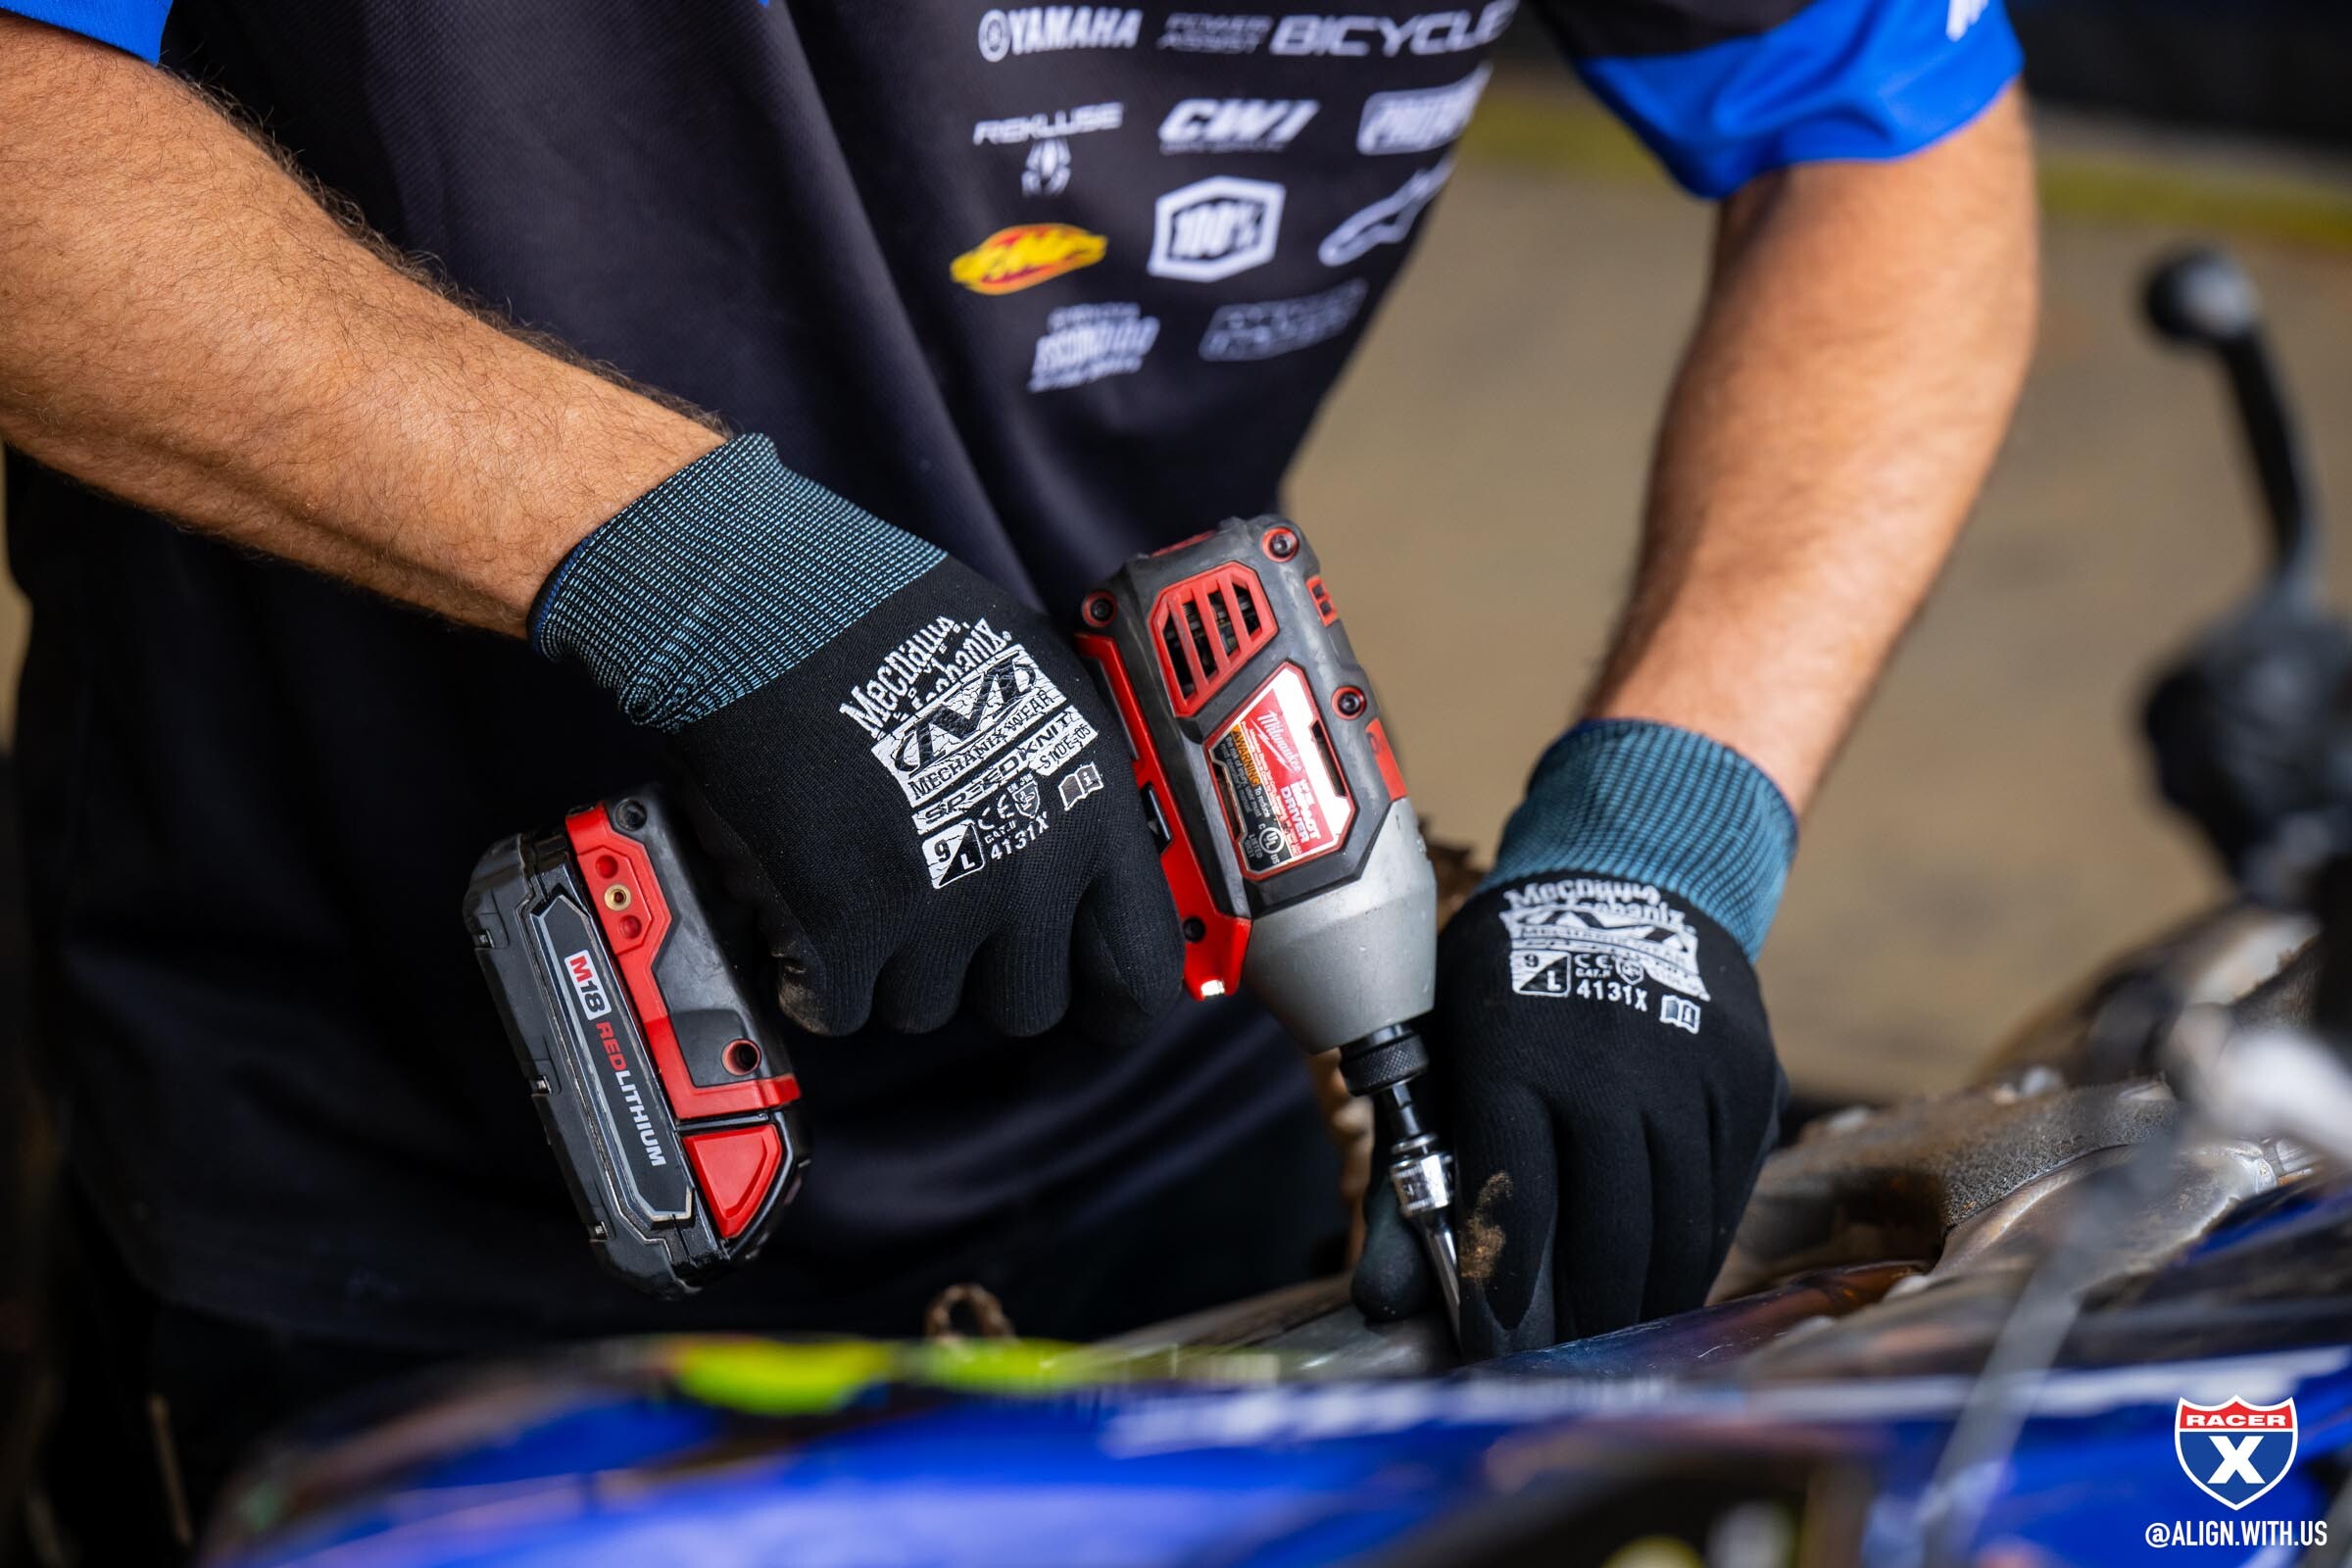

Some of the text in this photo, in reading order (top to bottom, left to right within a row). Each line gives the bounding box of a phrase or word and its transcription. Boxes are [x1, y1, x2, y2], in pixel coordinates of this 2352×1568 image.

[1007, 5, 1144, 56] YAMAHA
[973, 101, 1124, 146] REKLUSE
[907, 689, 1055, 801] MECHANIX WEAR
[1257, 710, 1299, 771] Milwaukee
[924, 714, 1073, 824] SPEEDKNIT
[1234, 738, 1271, 817] WARNING To reduce
[990, 810, 1050, 861] 4131X
[1279, 785, 1309, 843] DRIVER
[933, 839, 953, 864] 9
[959, 853, 977, 870] L
[1248, 833, 1263, 858] LISTED
[1269, 853, 1280, 864] US
[1523, 955, 1541, 969] 9
[1546, 969, 1562, 992] L
[1576, 979, 1649, 1011] 4131X
[569, 955, 667, 1167] M18 REDLITHIUM
